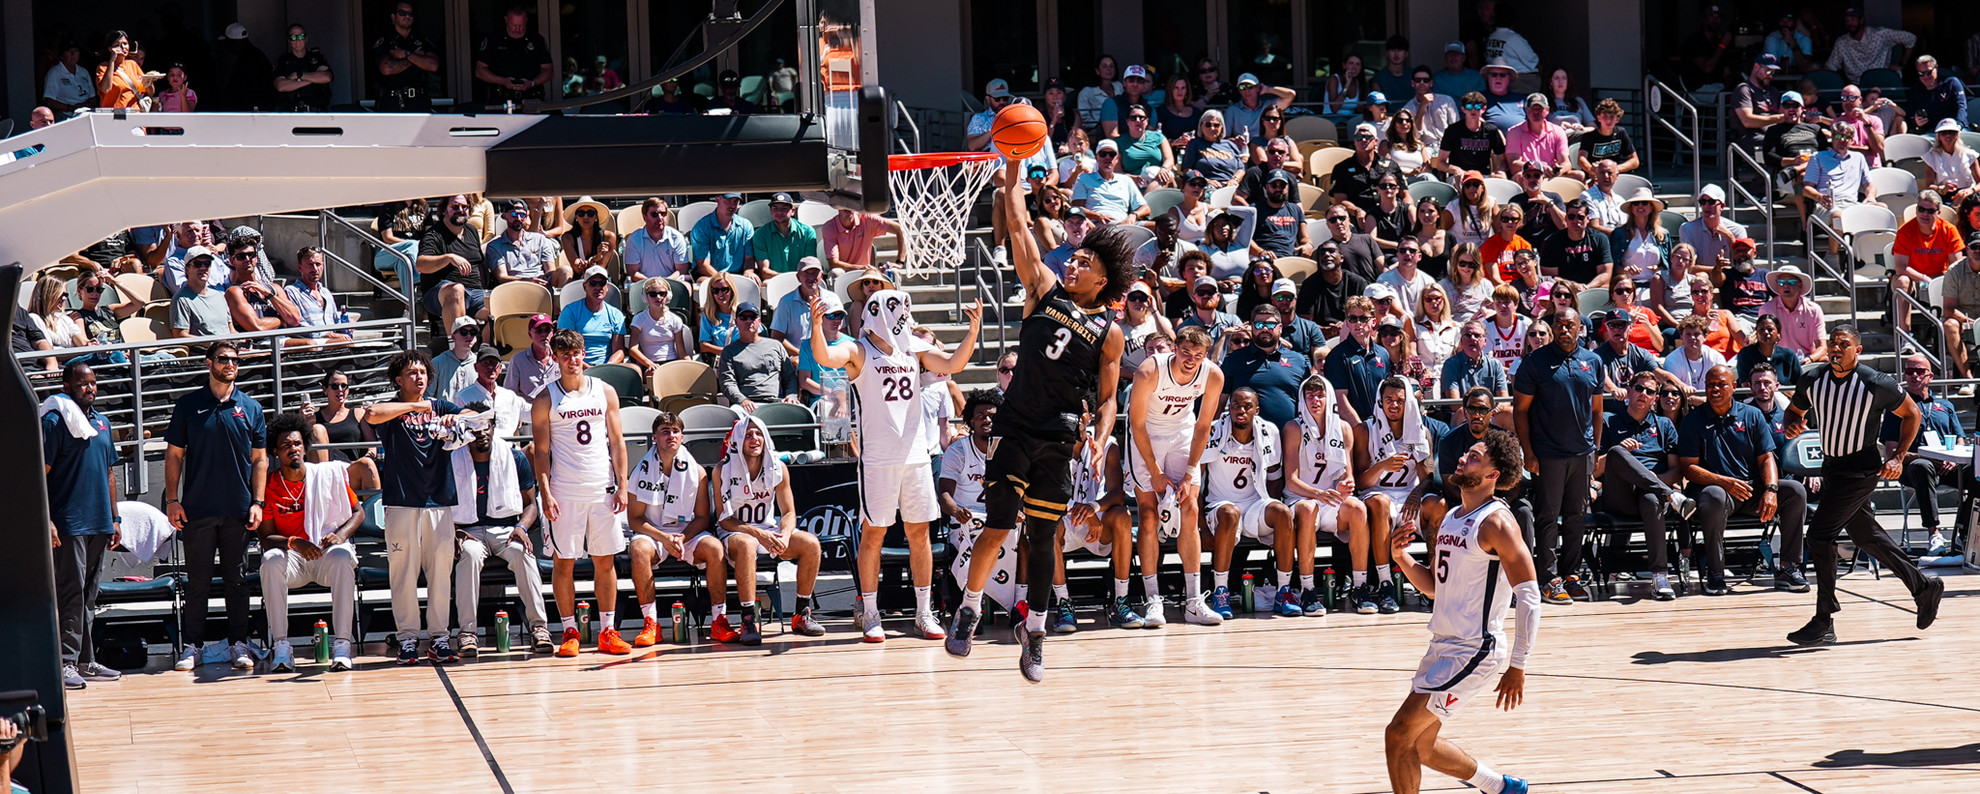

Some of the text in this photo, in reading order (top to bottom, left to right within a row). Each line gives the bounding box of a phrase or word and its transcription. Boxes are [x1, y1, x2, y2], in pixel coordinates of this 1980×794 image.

[1045, 305, 1097, 345] VANDERBILT
[1045, 326, 1073, 361] 3
[874, 366, 916, 375] VIRGINIA
[882, 375, 914, 402] 28
[558, 408, 603, 420] VIRGINIA
[1162, 403, 1189, 416] 17
[576, 419, 592, 446] 8
[1233, 467, 1248, 490] 6
[1312, 462, 1328, 485] 7
[738, 502, 767, 525] 00
[1437, 549, 1451, 584] 5
